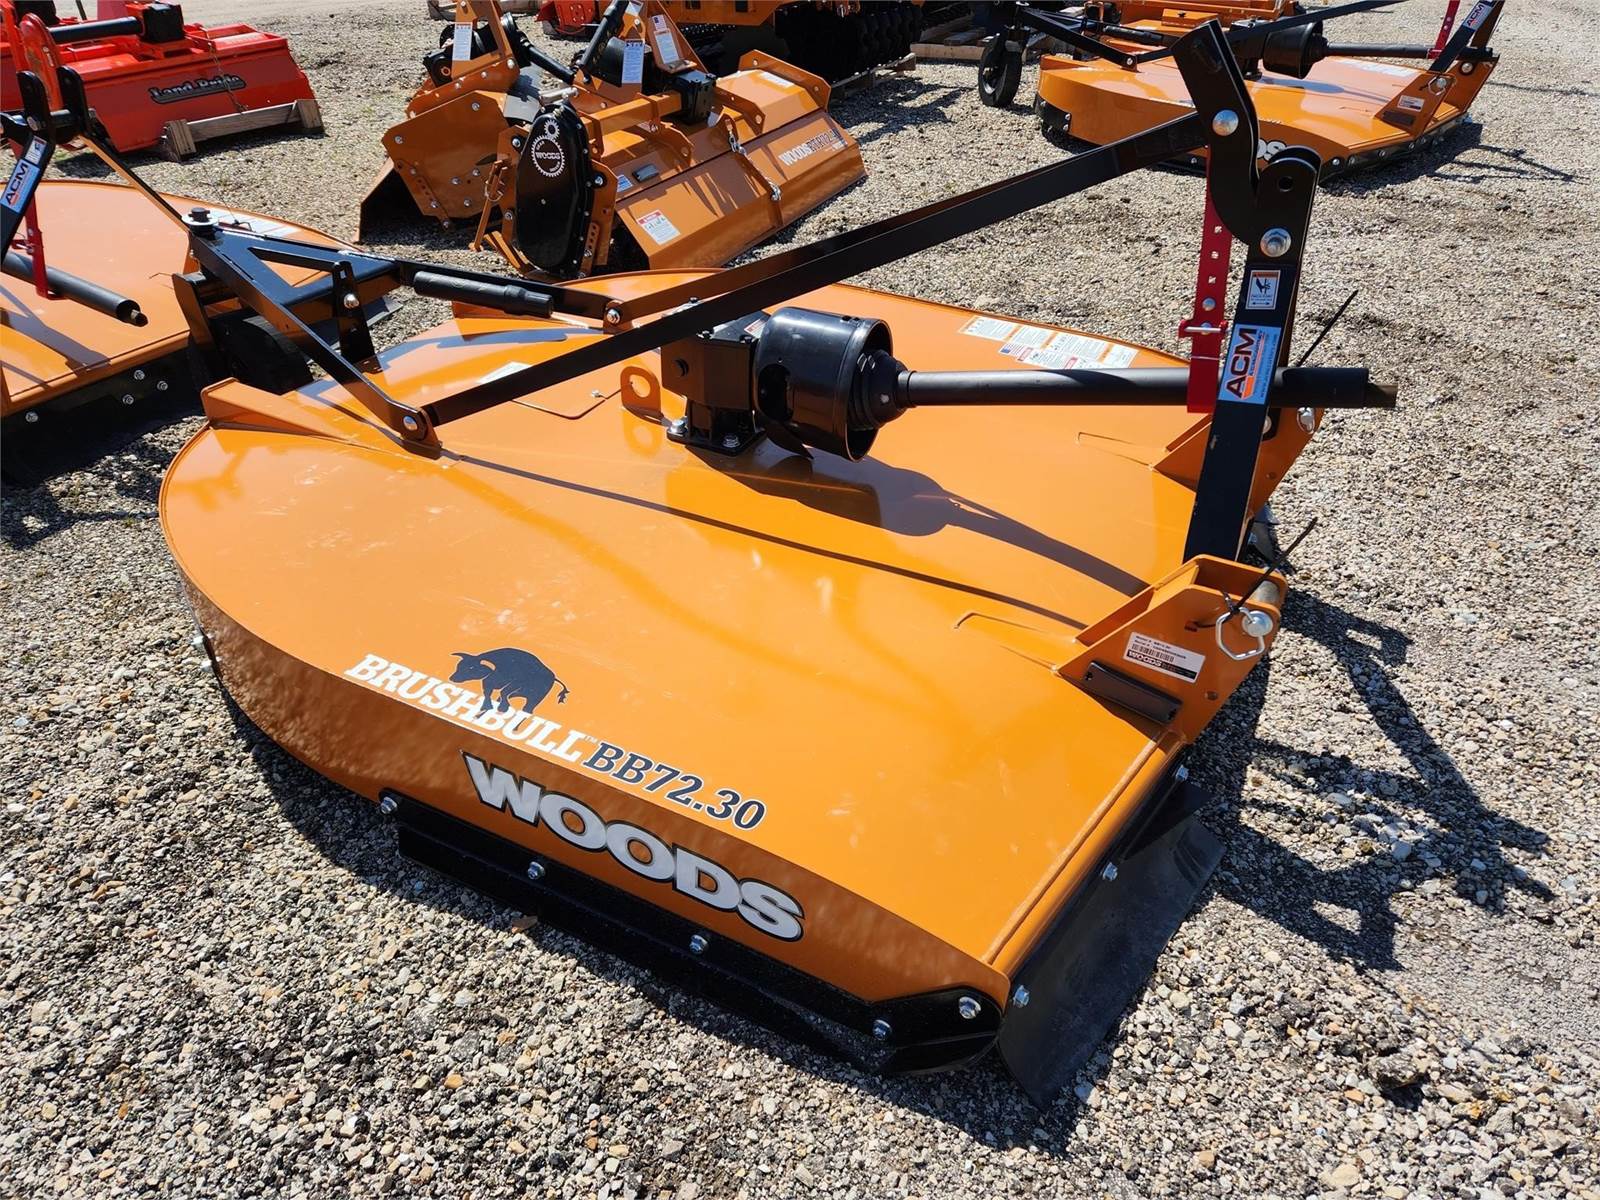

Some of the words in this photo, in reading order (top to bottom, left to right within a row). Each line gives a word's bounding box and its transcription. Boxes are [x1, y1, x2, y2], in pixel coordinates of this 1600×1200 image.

[1467, 4, 1485, 26] ACM
[778, 143, 813, 166] WOODS
[5, 162, 29, 205] ACM
[1226, 328, 1257, 399] ACM
[1128, 651, 1162, 667] WOODS
[344, 654, 586, 763] BRUSHBULL
[583, 741, 766, 831] BB72.30
[461, 750, 804, 941] WOODS
